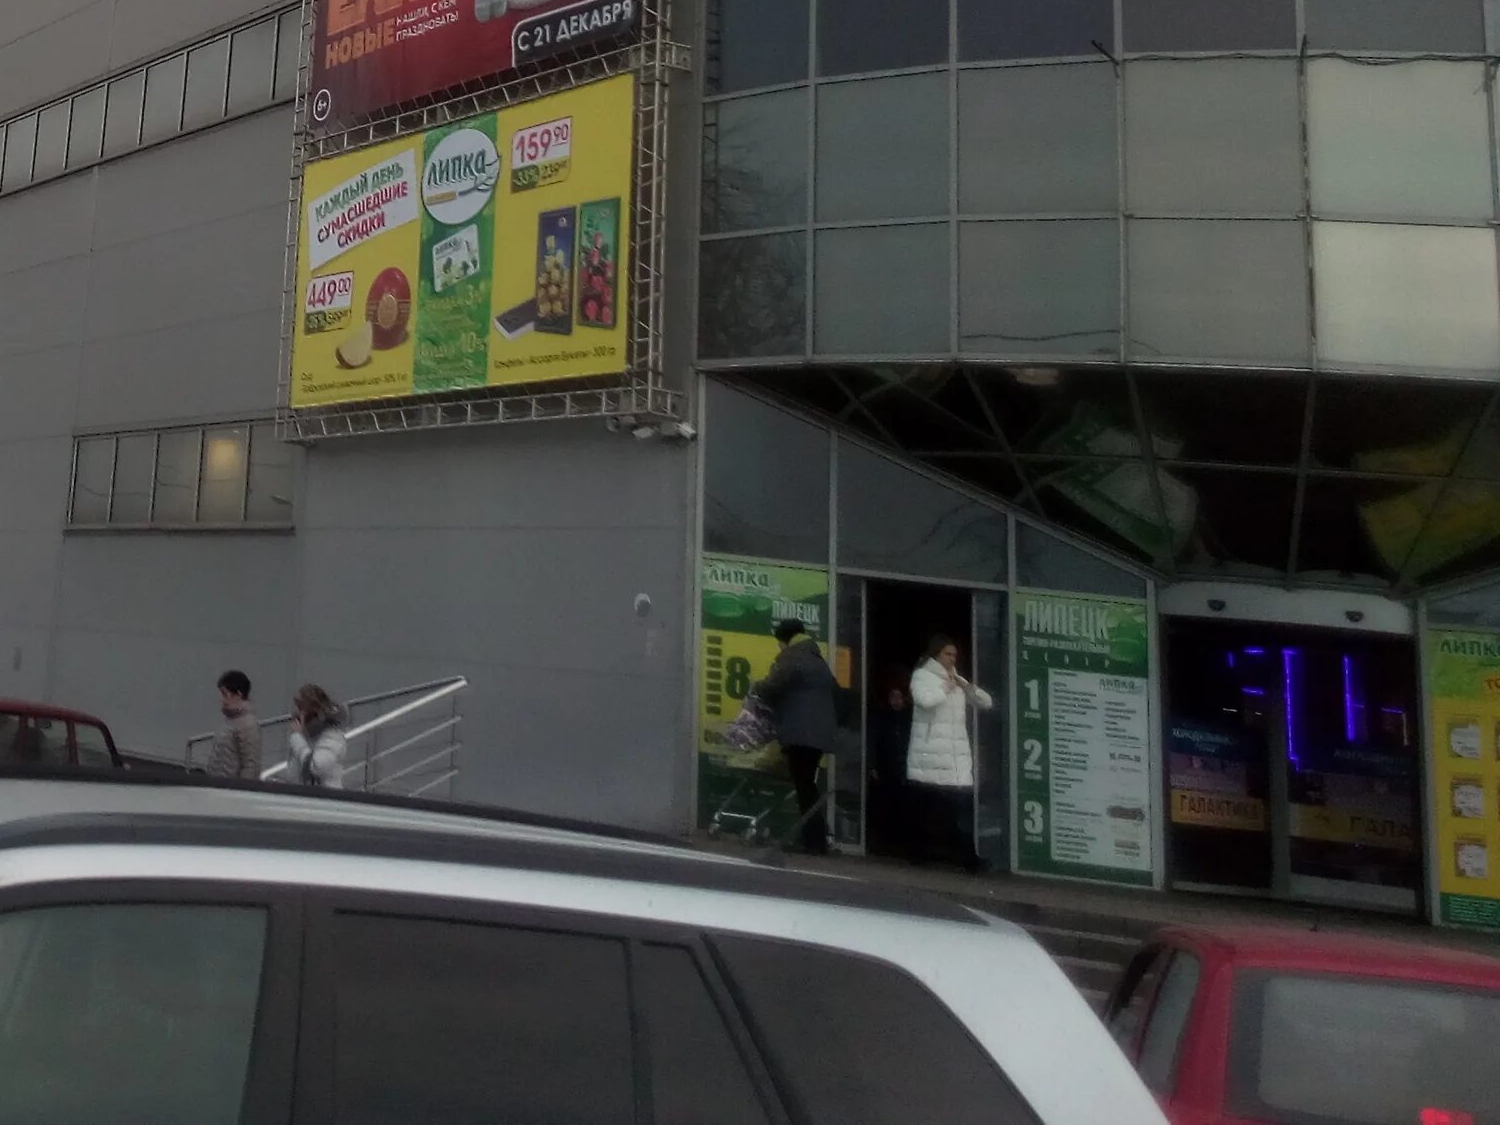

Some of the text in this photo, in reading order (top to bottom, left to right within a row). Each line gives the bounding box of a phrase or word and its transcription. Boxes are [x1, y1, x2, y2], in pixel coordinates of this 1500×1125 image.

[325, 18, 396, 70] НОВЫЕ
[518, 32, 531, 52] С
[534, 25, 551, 45] 21
[515, 123, 569, 163] 159 90
[315, 161, 404, 223] КАЖДЫЙ ДЕНЬ
[317, 181, 409, 243] СУМАСШЕДШИЕ
[337, 211, 386, 249] СКИДКИ
[307, 279, 337, 308] 449
[771, 600, 820, 625] ЛИПЕЦК
[1024, 601, 1109, 642] ЛИПЕЦК
[1024, 679, 1040, 711] 1
[1023, 738, 1043, 772] 2
[1023, 801, 1044, 834] 3
